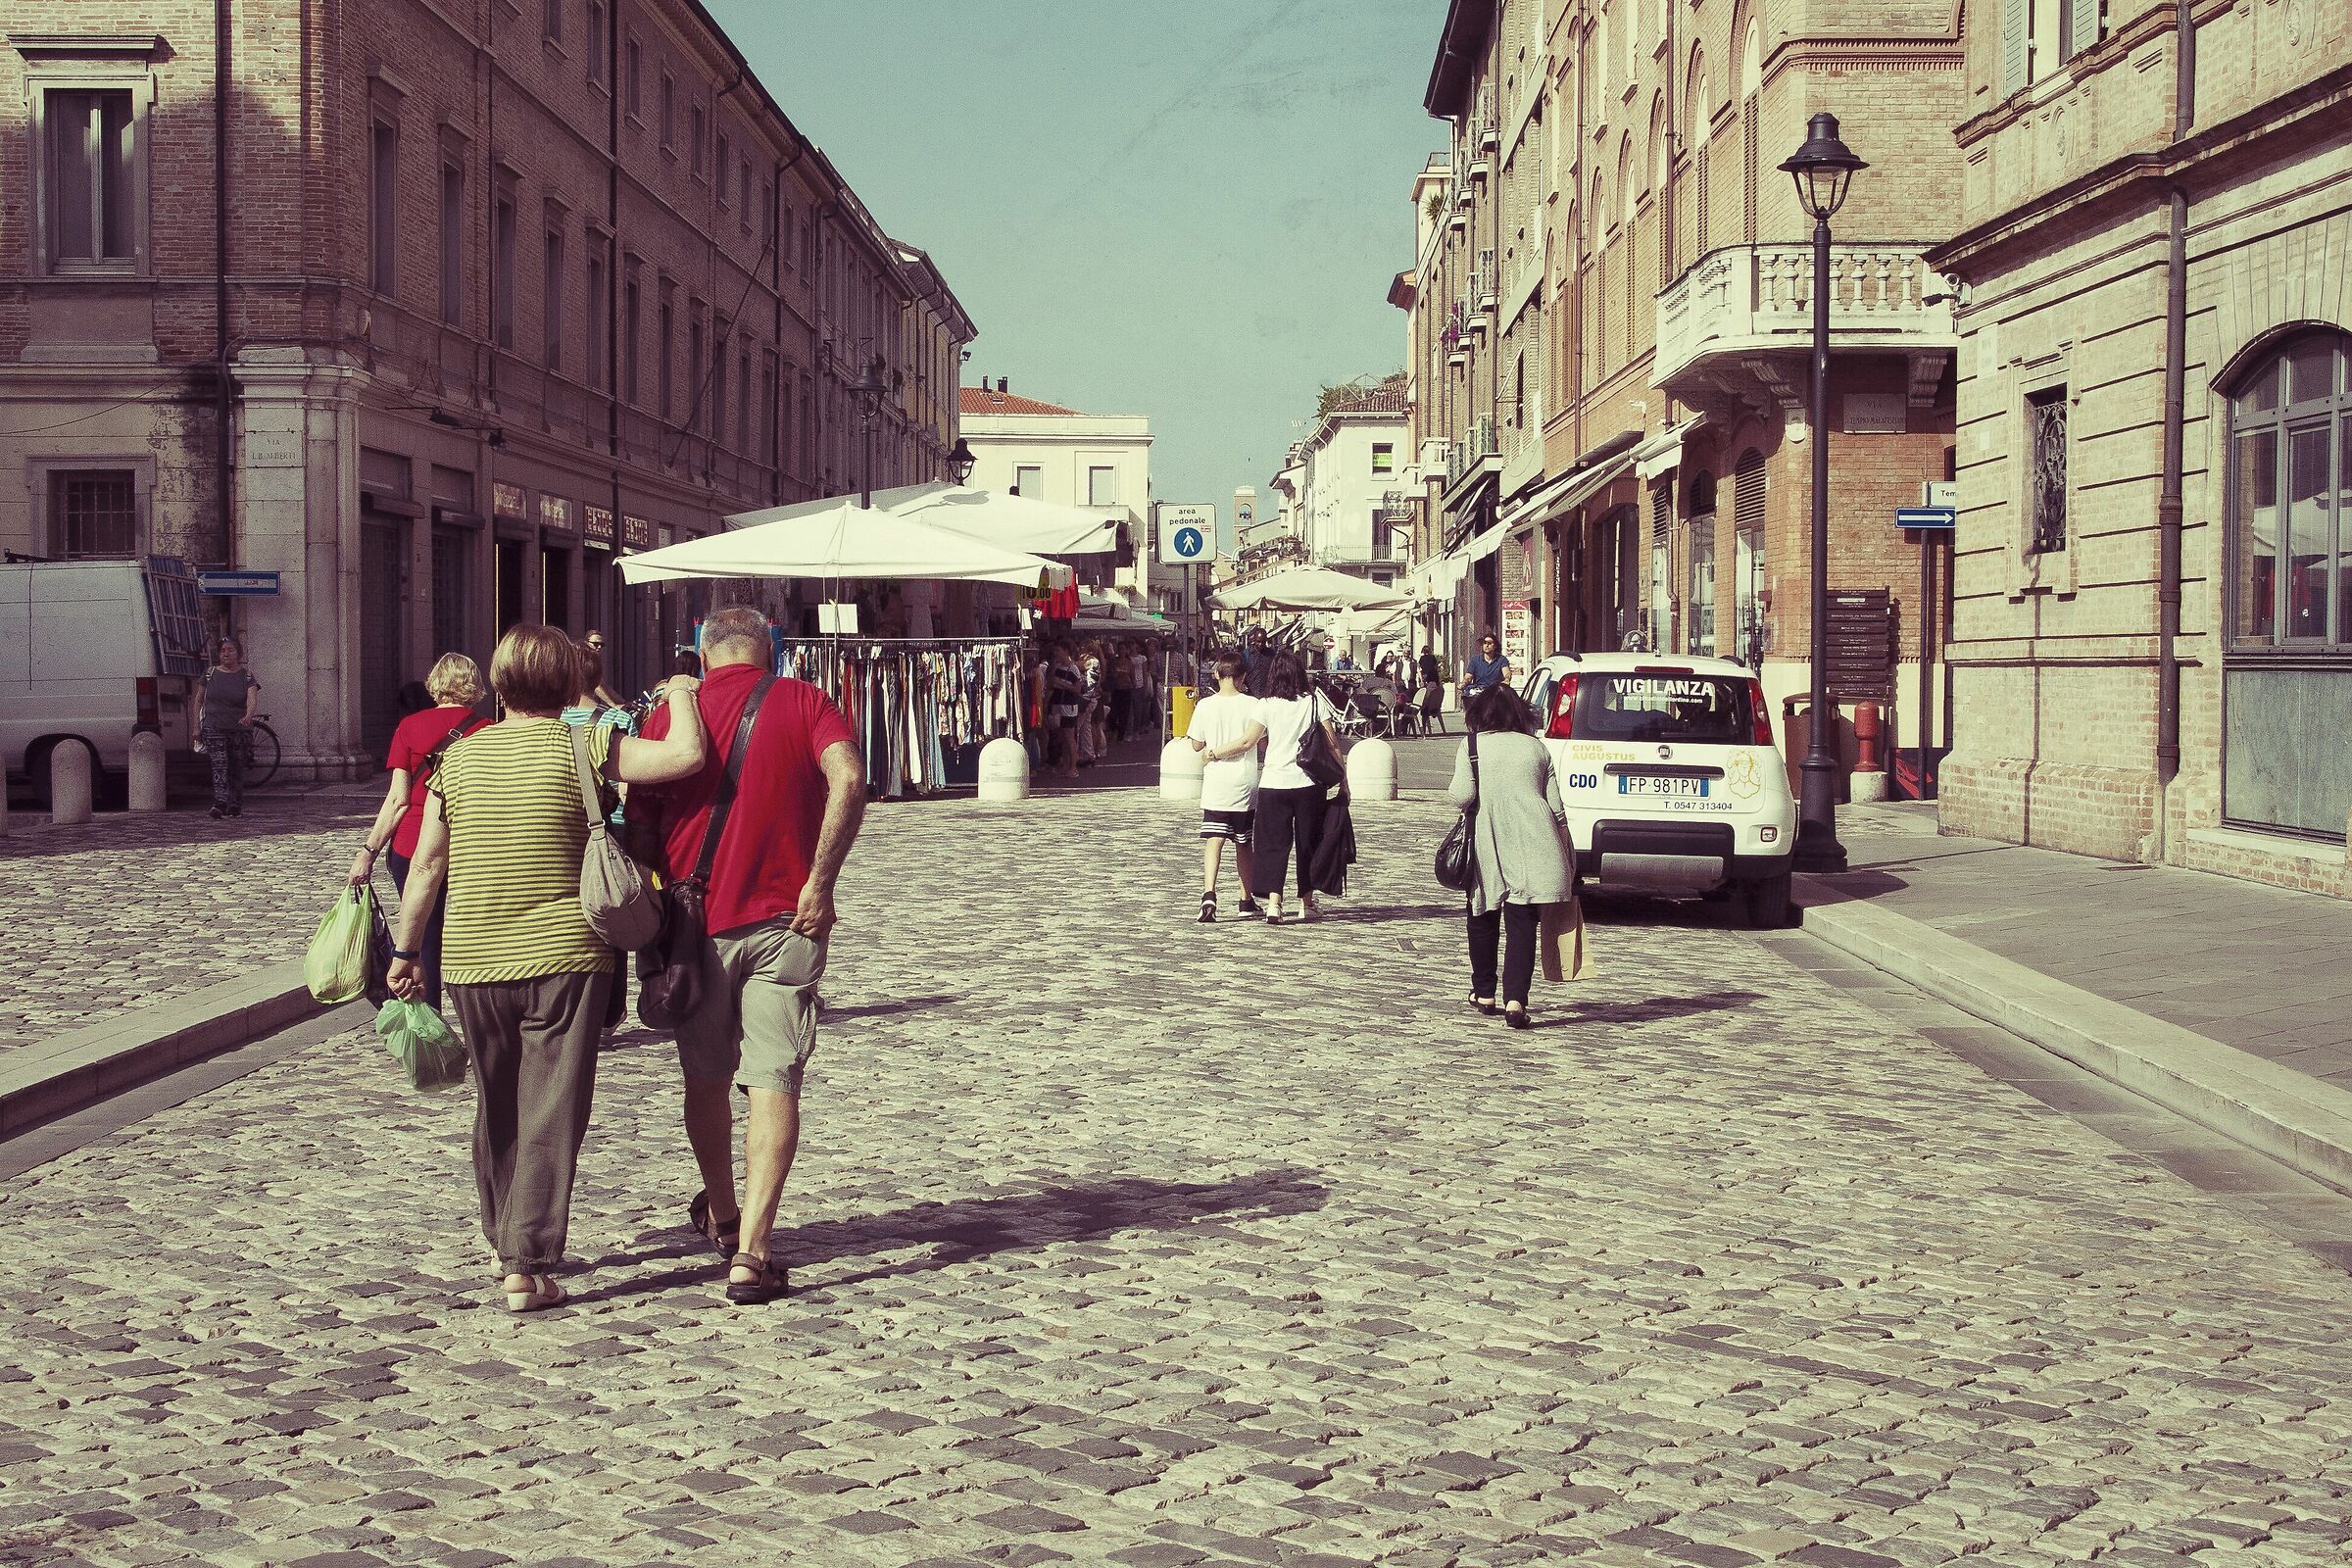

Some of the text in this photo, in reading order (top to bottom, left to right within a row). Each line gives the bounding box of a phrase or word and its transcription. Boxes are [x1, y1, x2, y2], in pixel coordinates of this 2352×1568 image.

[1612, 678, 1714, 697] VIGILANZA
[1569, 773, 1597, 789] CDO
[1664, 801, 1672, 809] T.
[1674, 802, 1697, 810] 0547
